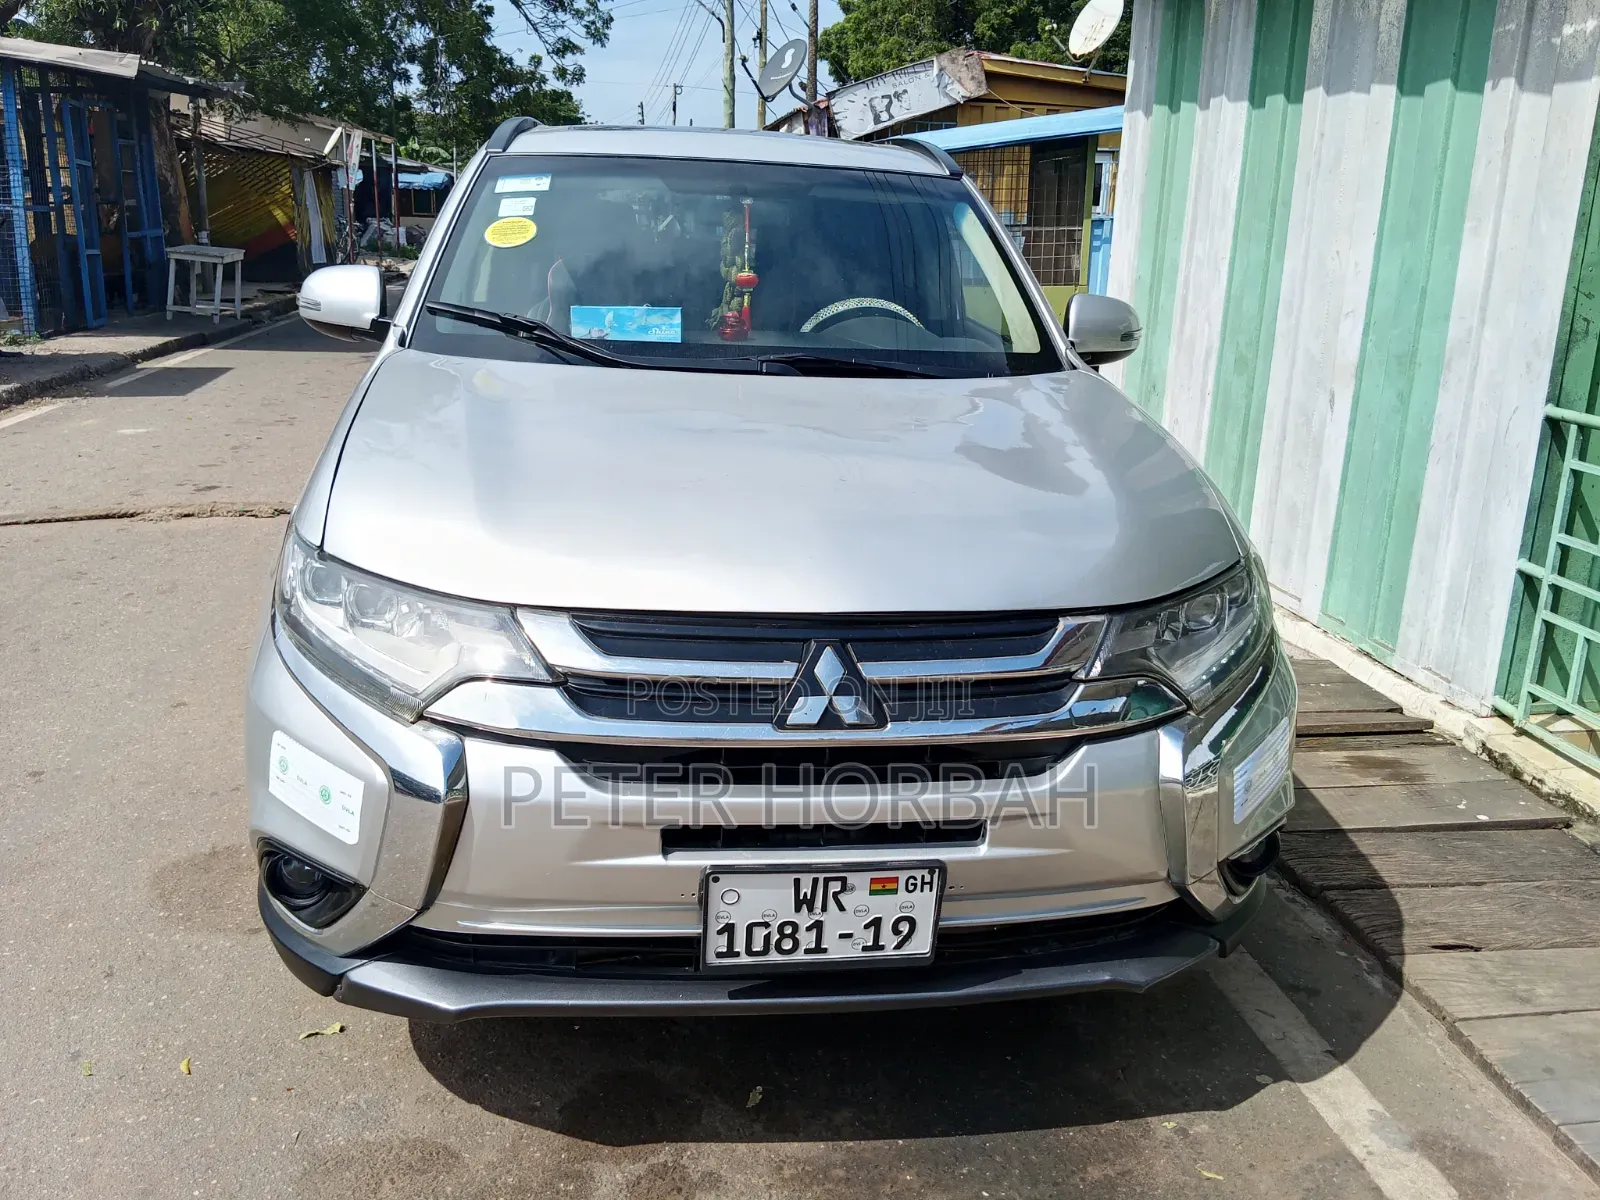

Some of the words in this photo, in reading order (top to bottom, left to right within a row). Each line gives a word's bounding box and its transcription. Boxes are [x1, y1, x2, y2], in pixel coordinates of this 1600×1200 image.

[892, 75, 921, 89] SALON
[341, 804, 355, 816] DVLA
[904, 874, 934, 894] GH
[793, 876, 848, 913] WR
